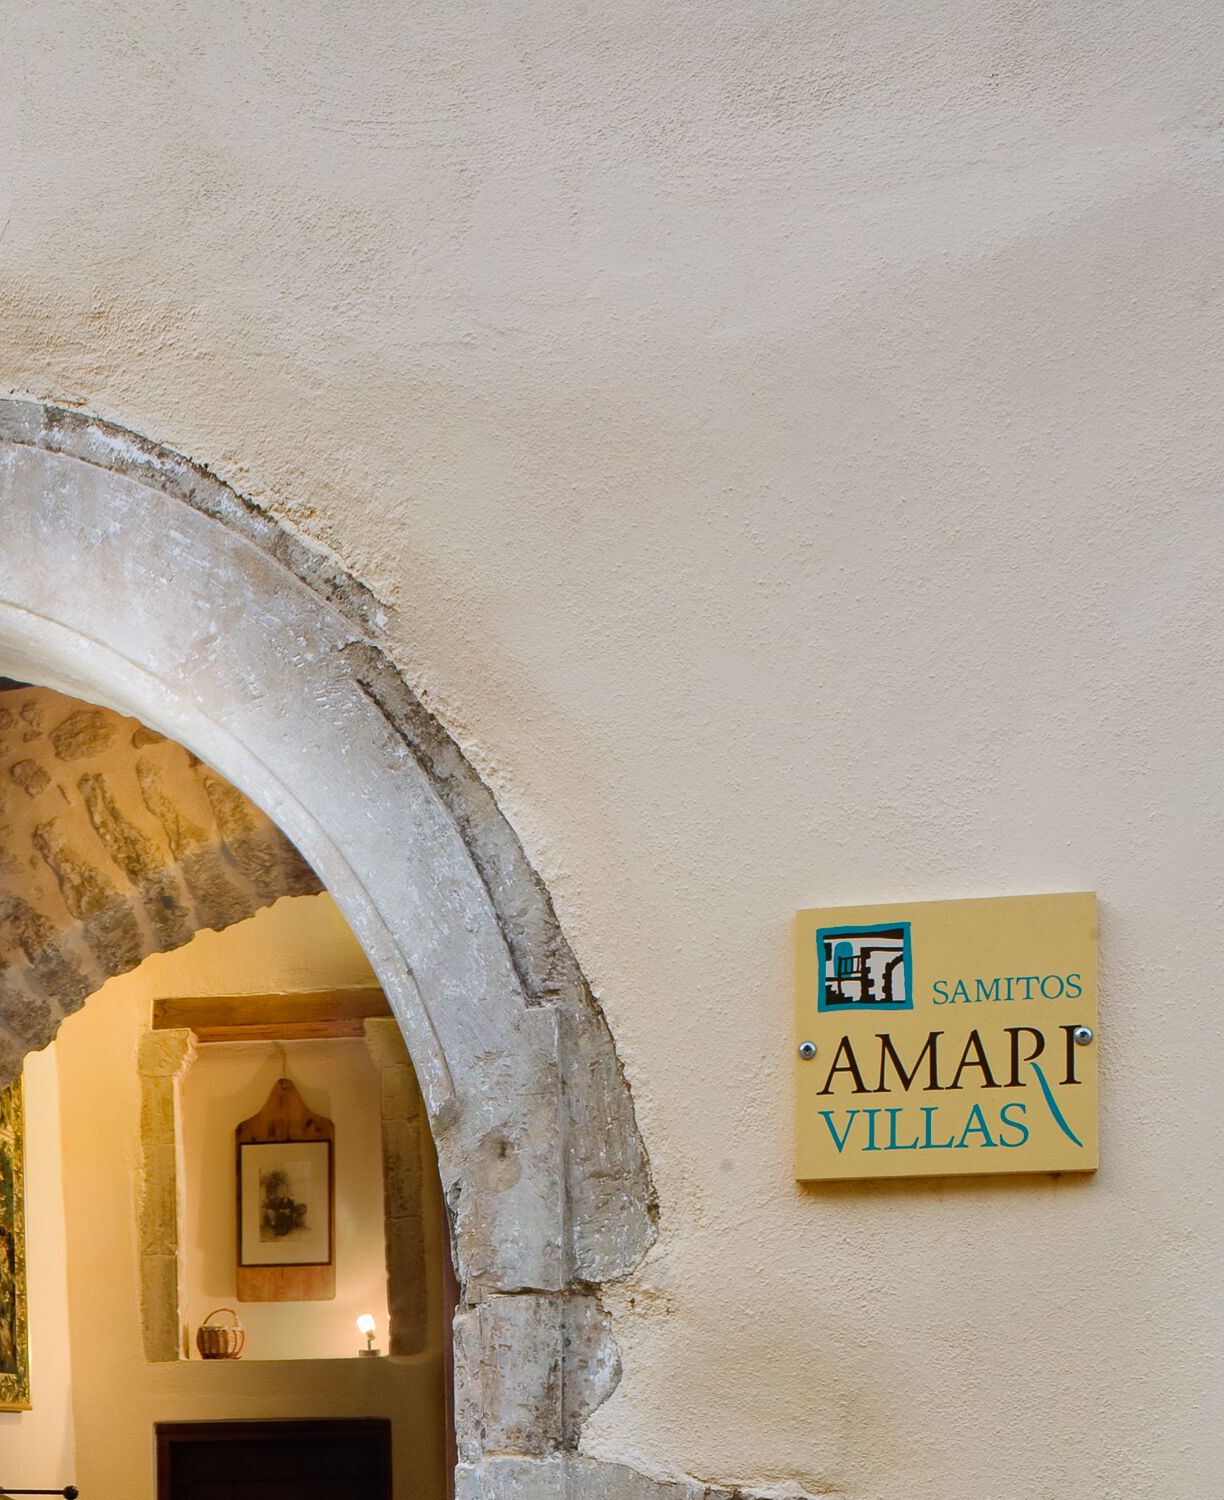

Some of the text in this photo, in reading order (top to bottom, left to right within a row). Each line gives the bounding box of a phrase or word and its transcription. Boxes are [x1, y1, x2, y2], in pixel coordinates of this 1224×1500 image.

[932, 973, 1083, 1005] SAMITOS
[816, 1024, 1083, 1148] AMARI
[817, 1103, 1030, 1153] VILLAS
